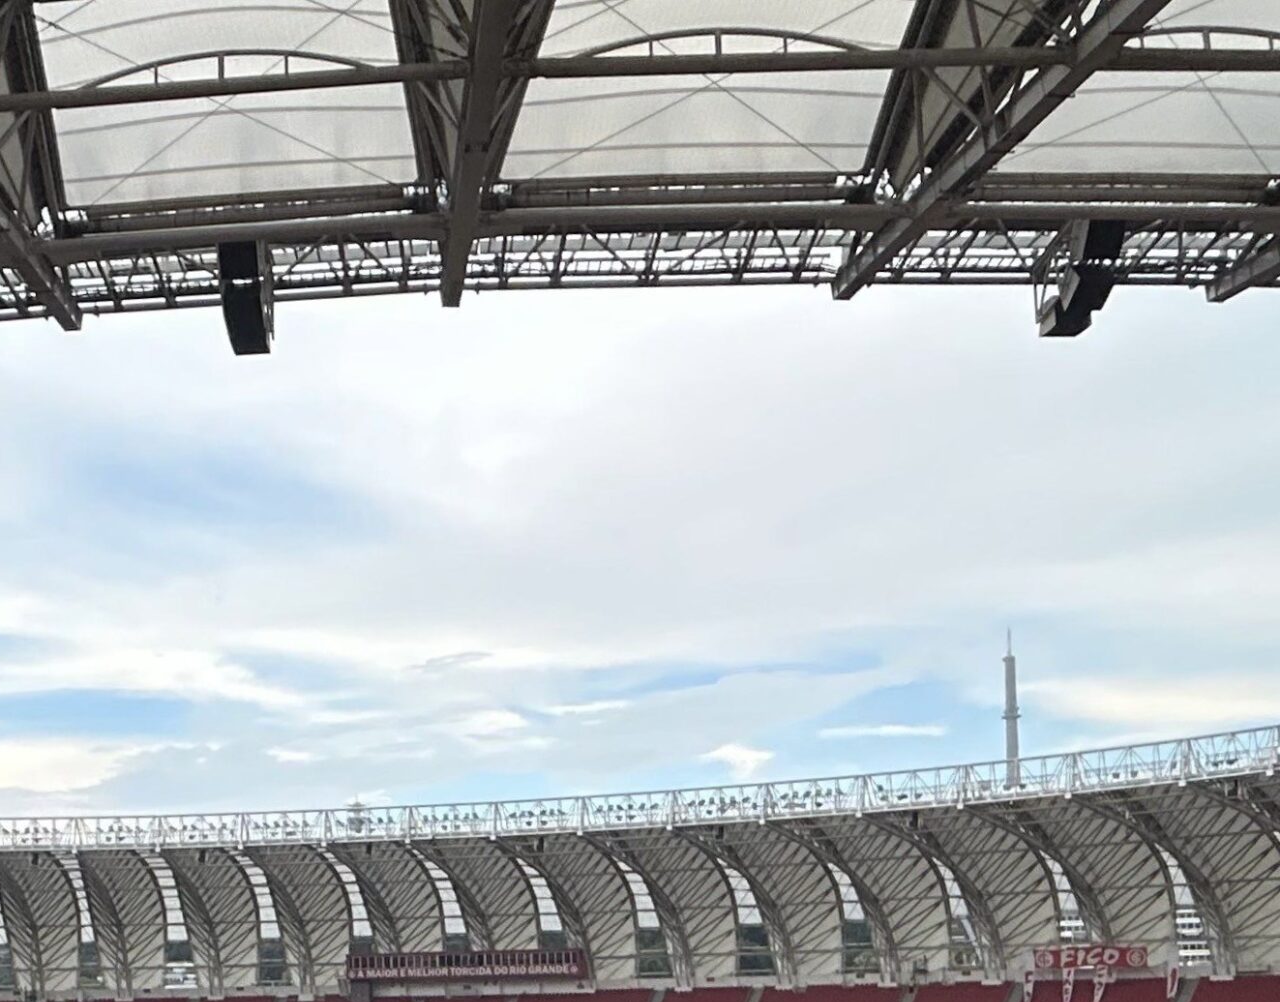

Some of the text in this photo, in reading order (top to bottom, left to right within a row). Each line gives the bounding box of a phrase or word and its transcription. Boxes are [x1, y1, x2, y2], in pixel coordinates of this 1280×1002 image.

[1061, 948, 1120, 967] FICO
[357, 965, 569, 978] A MAIOR E MELHOR TORCIDA DO RIO GRANDE
